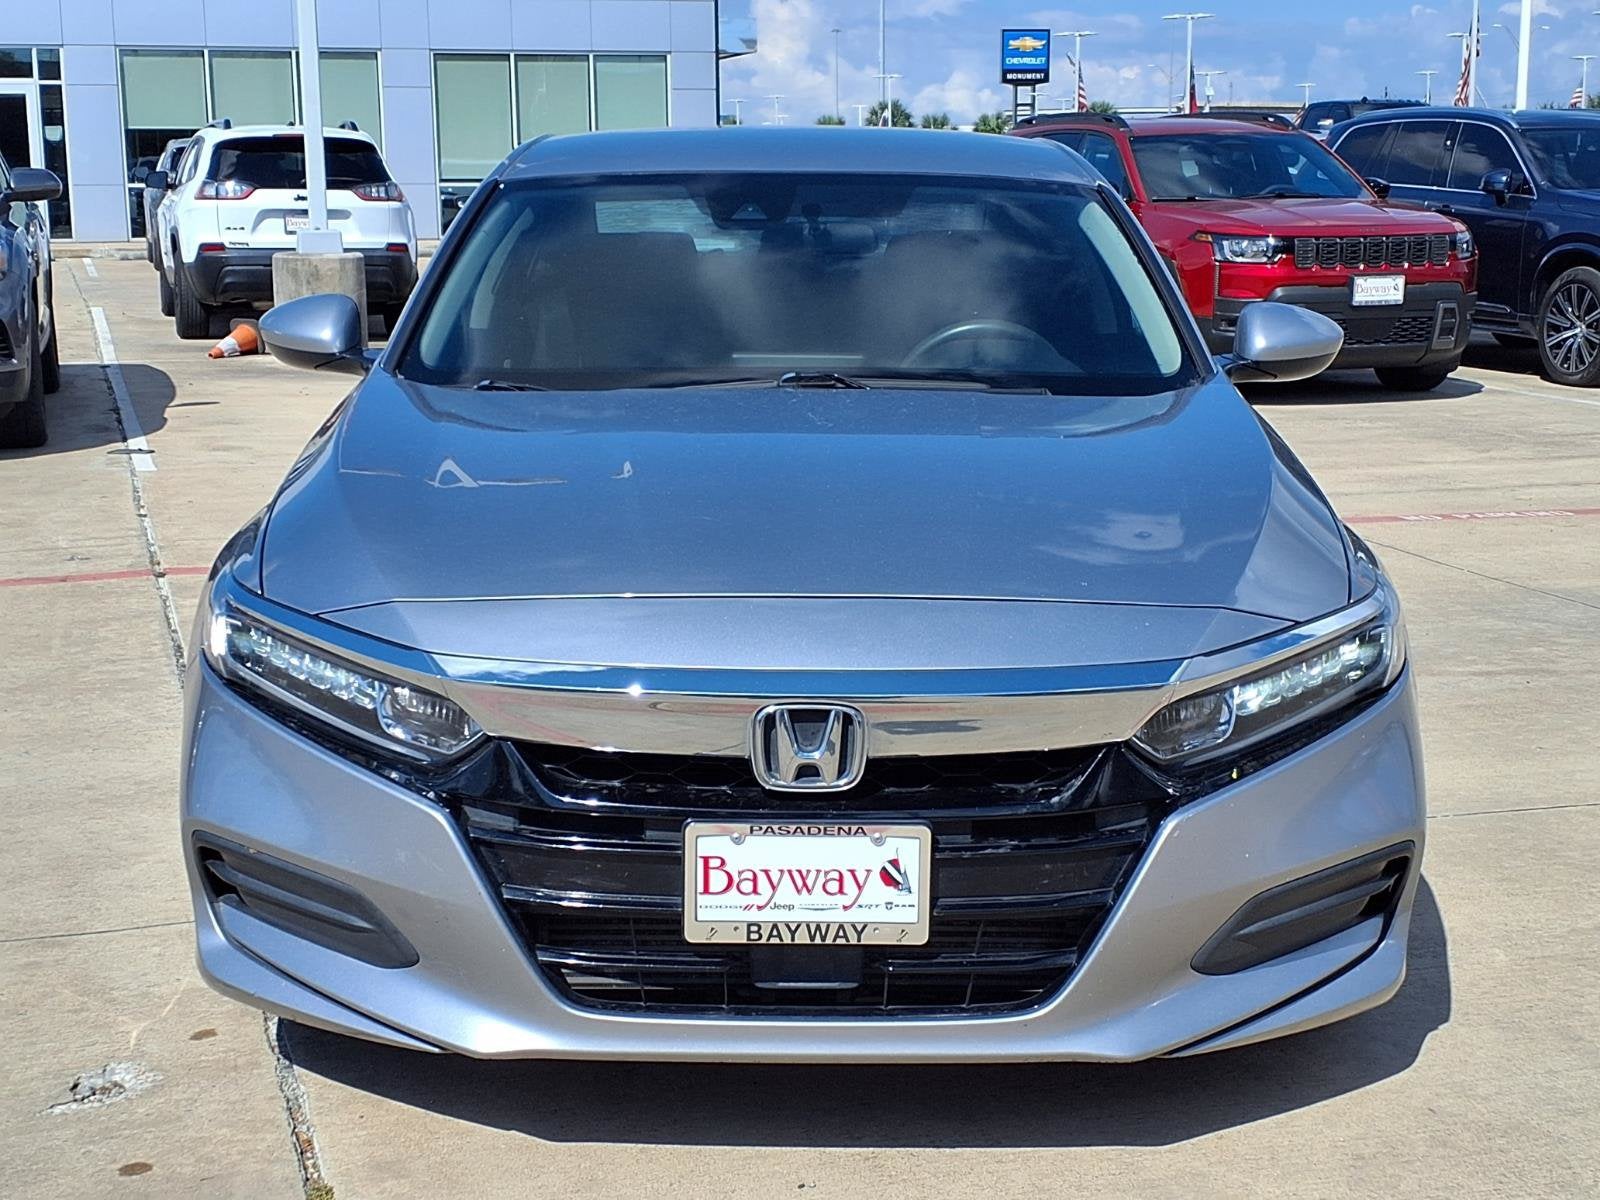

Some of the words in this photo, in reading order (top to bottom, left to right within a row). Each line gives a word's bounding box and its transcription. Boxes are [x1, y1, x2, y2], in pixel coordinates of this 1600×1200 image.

[1005, 57, 1046, 65] CHEVROLET
[1356, 283, 1392, 295] Bayway
[749, 825, 868, 836] PASADENA
[698, 855, 873, 912] Bayway
[770, 901, 795, 912] Jeep
[746, 923, 869, 943] BAYWAY
